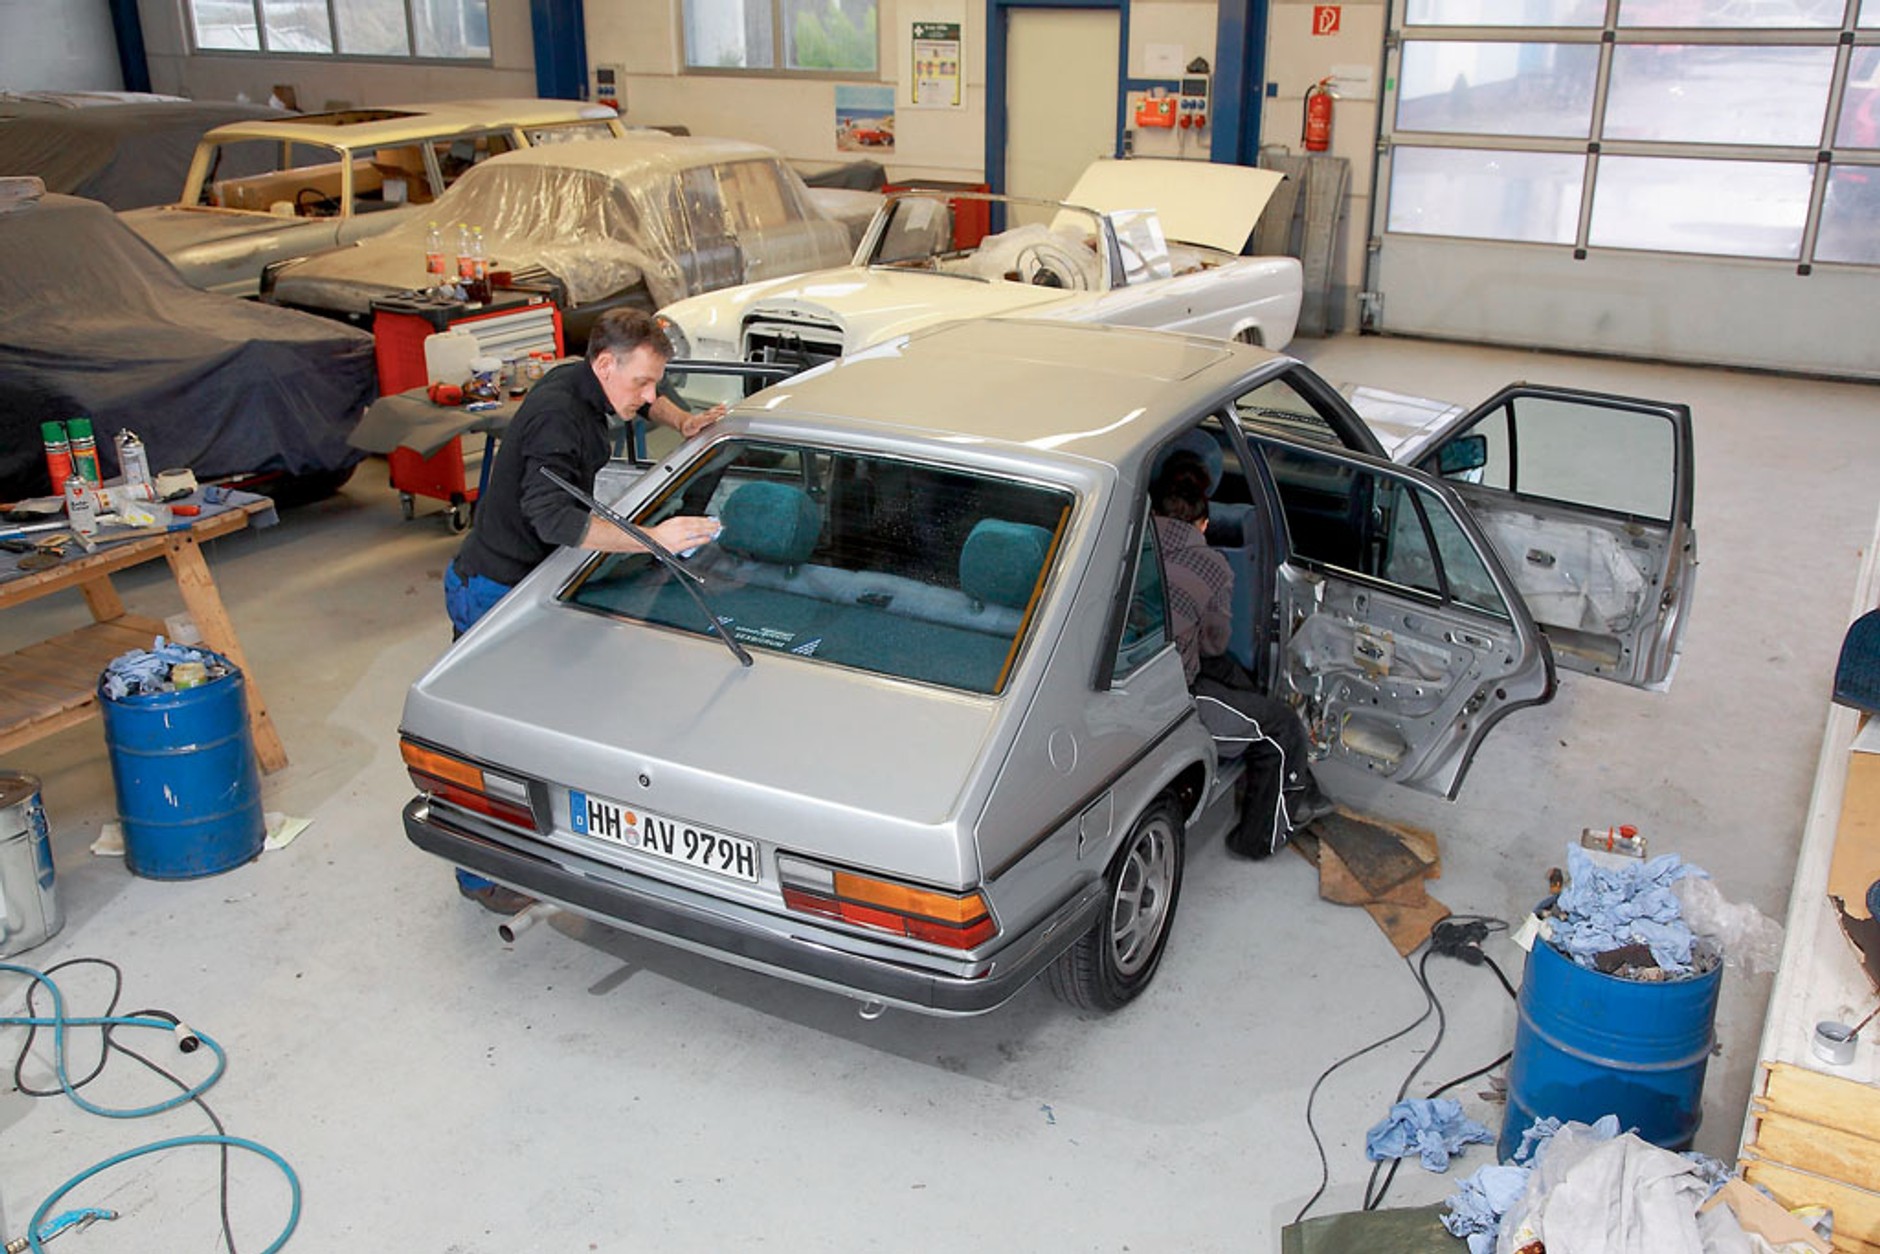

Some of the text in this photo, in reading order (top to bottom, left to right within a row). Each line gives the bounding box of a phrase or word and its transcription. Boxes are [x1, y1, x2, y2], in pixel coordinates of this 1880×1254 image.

[588, 800, 754, 877] HH AV 979H
